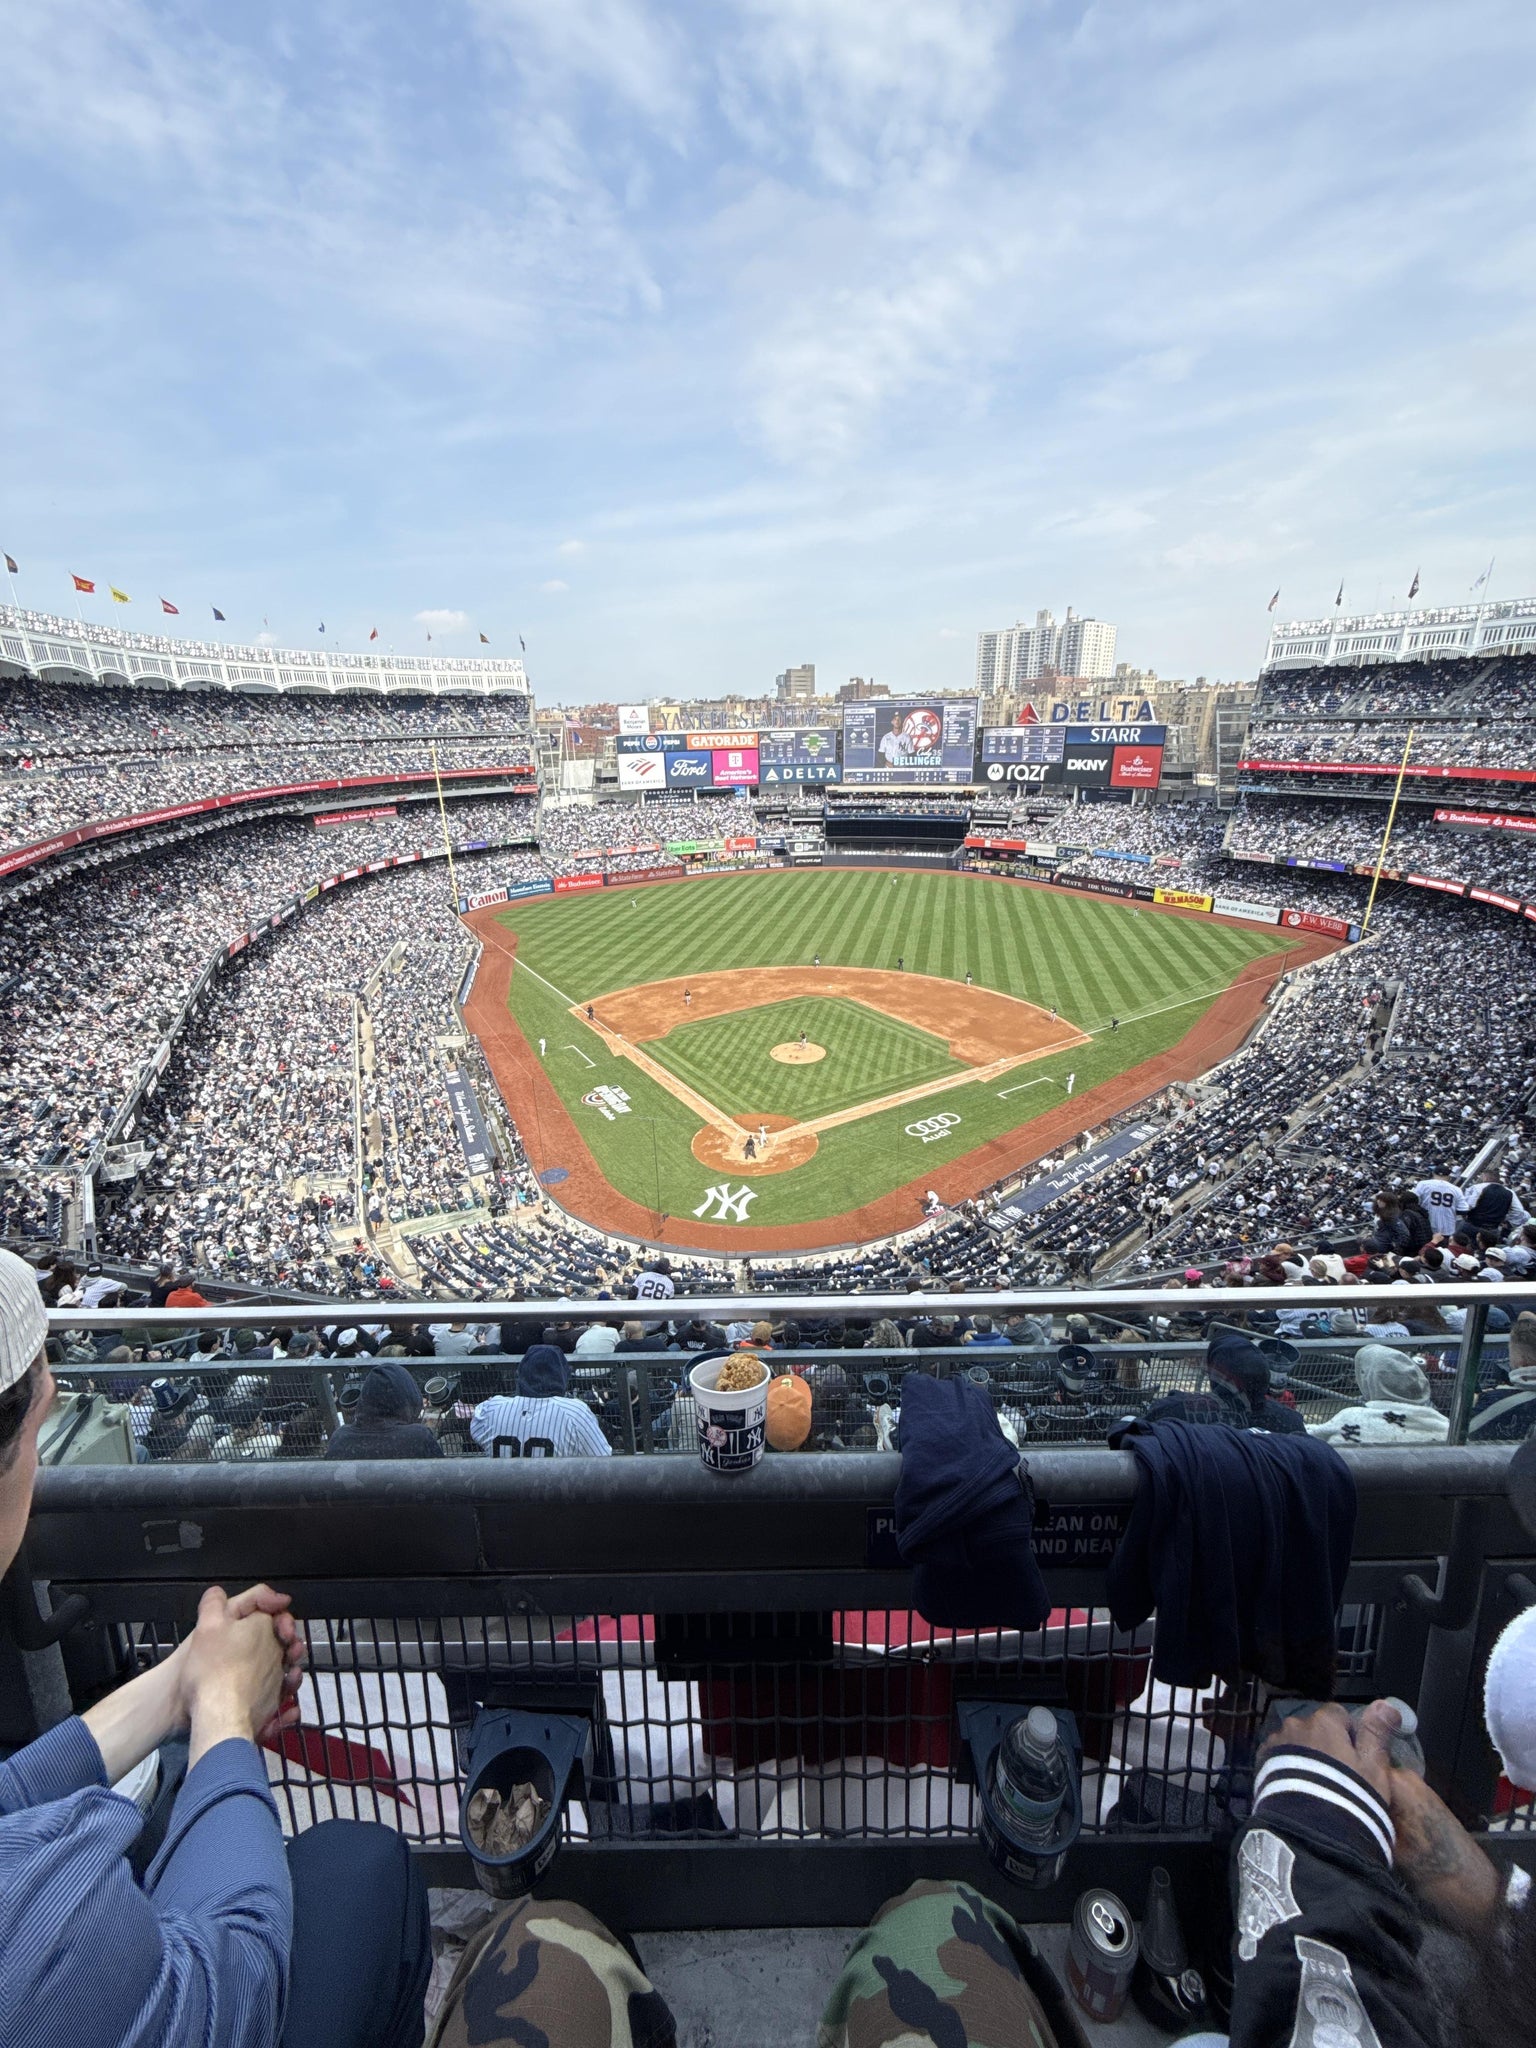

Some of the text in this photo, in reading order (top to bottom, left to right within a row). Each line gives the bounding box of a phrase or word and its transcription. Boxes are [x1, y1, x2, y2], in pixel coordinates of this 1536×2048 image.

[1052, 700, 1156, 722] DELTA
[660, 710, 818, 730] YANKEE STADIUM
[691, 735, 754, 746] GATORADE
[1090, 728, 1141, 742] STARR
[671, 760, 707, 776] Ford
[894, 757, 941, 766] BELLINGER
[1067, 759, 1108, 770] DKNY
[783, 768, 837, 779] DELTA
[1007, 764, 1049, 781] razr
[1449, 814, 1490, 824] Budweiser
[429, 849, 446, 857] ORIS
[568, 879, 600, 888] Budweiser
[1102, 885, 1124, 894] VODKA
[469, 890, 507, 907] Canon
[1239, 908, 1264, 916] AMERICA
[1319, 917, 1343, 930] WEBB
[922, 1129, 952, 1143] Audi
[1047, 1154, 1110, 1190] New York Yankees
[1430, 1191, 1454, 1208] 99
[641, 1280, 666, 1300] 28
[1090, 1515, 1123, 1532] ON,
